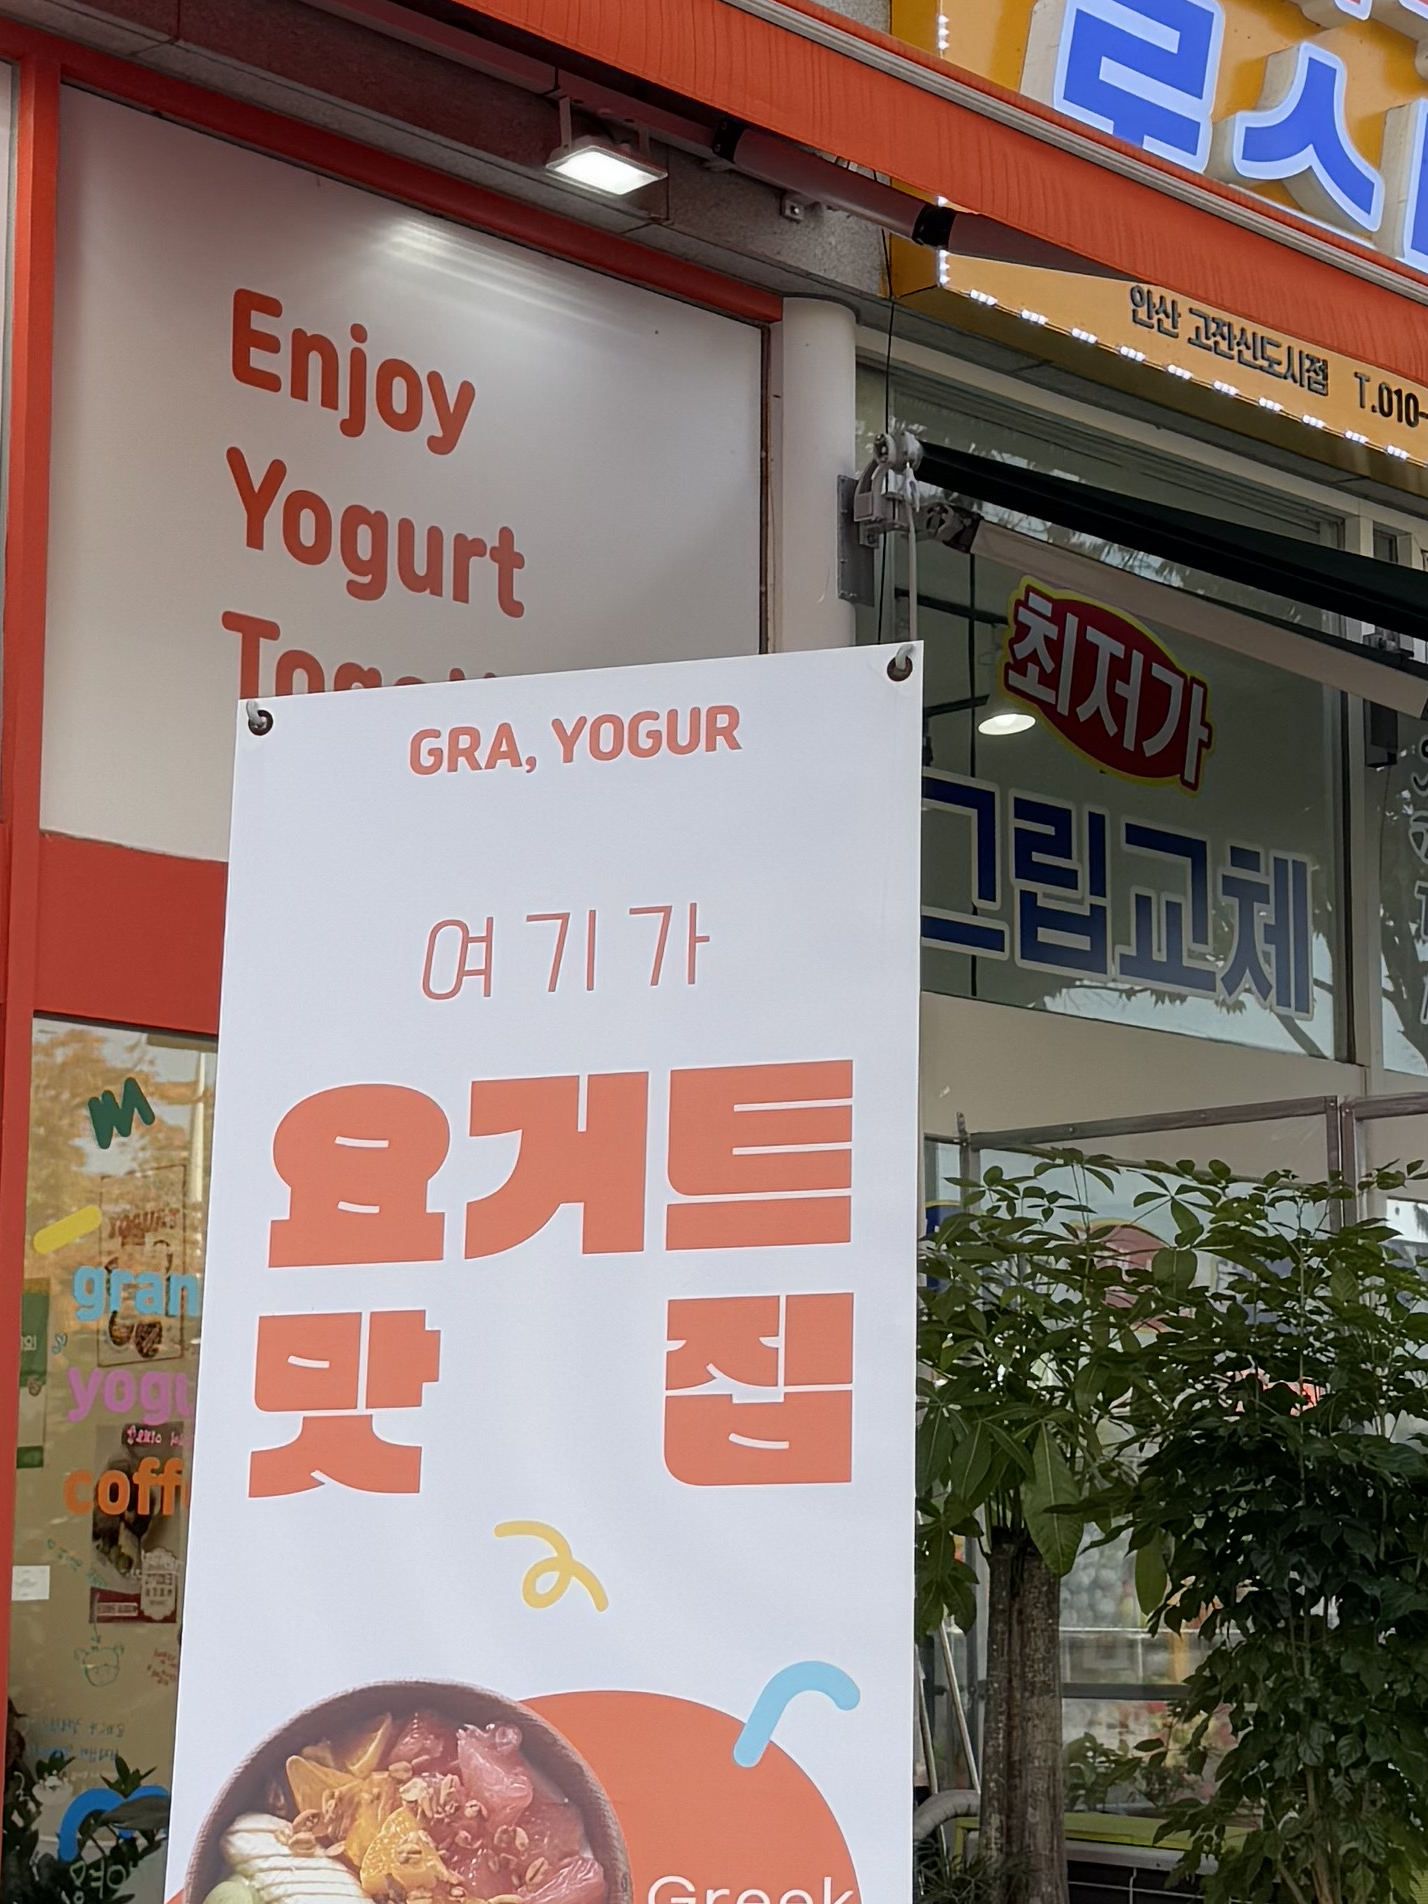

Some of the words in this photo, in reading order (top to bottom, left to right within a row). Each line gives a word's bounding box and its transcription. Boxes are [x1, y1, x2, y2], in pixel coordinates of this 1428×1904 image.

[232, 288, 476, 456] Enjoy
[1130, 282, 1182, 337] 안산
[1186, 307, 1331, 398] 고잔신도시점
[224, 445, 526, 620] Yogurt
[410, 725, 538, 778] GRA,
[551, 704, 742, 764] YOGUR
[1009, 601, 1212, 789] 최저가
[922, 775, 1310, 1017] 그립교체
[63, 1456, 190, 1516] coff
